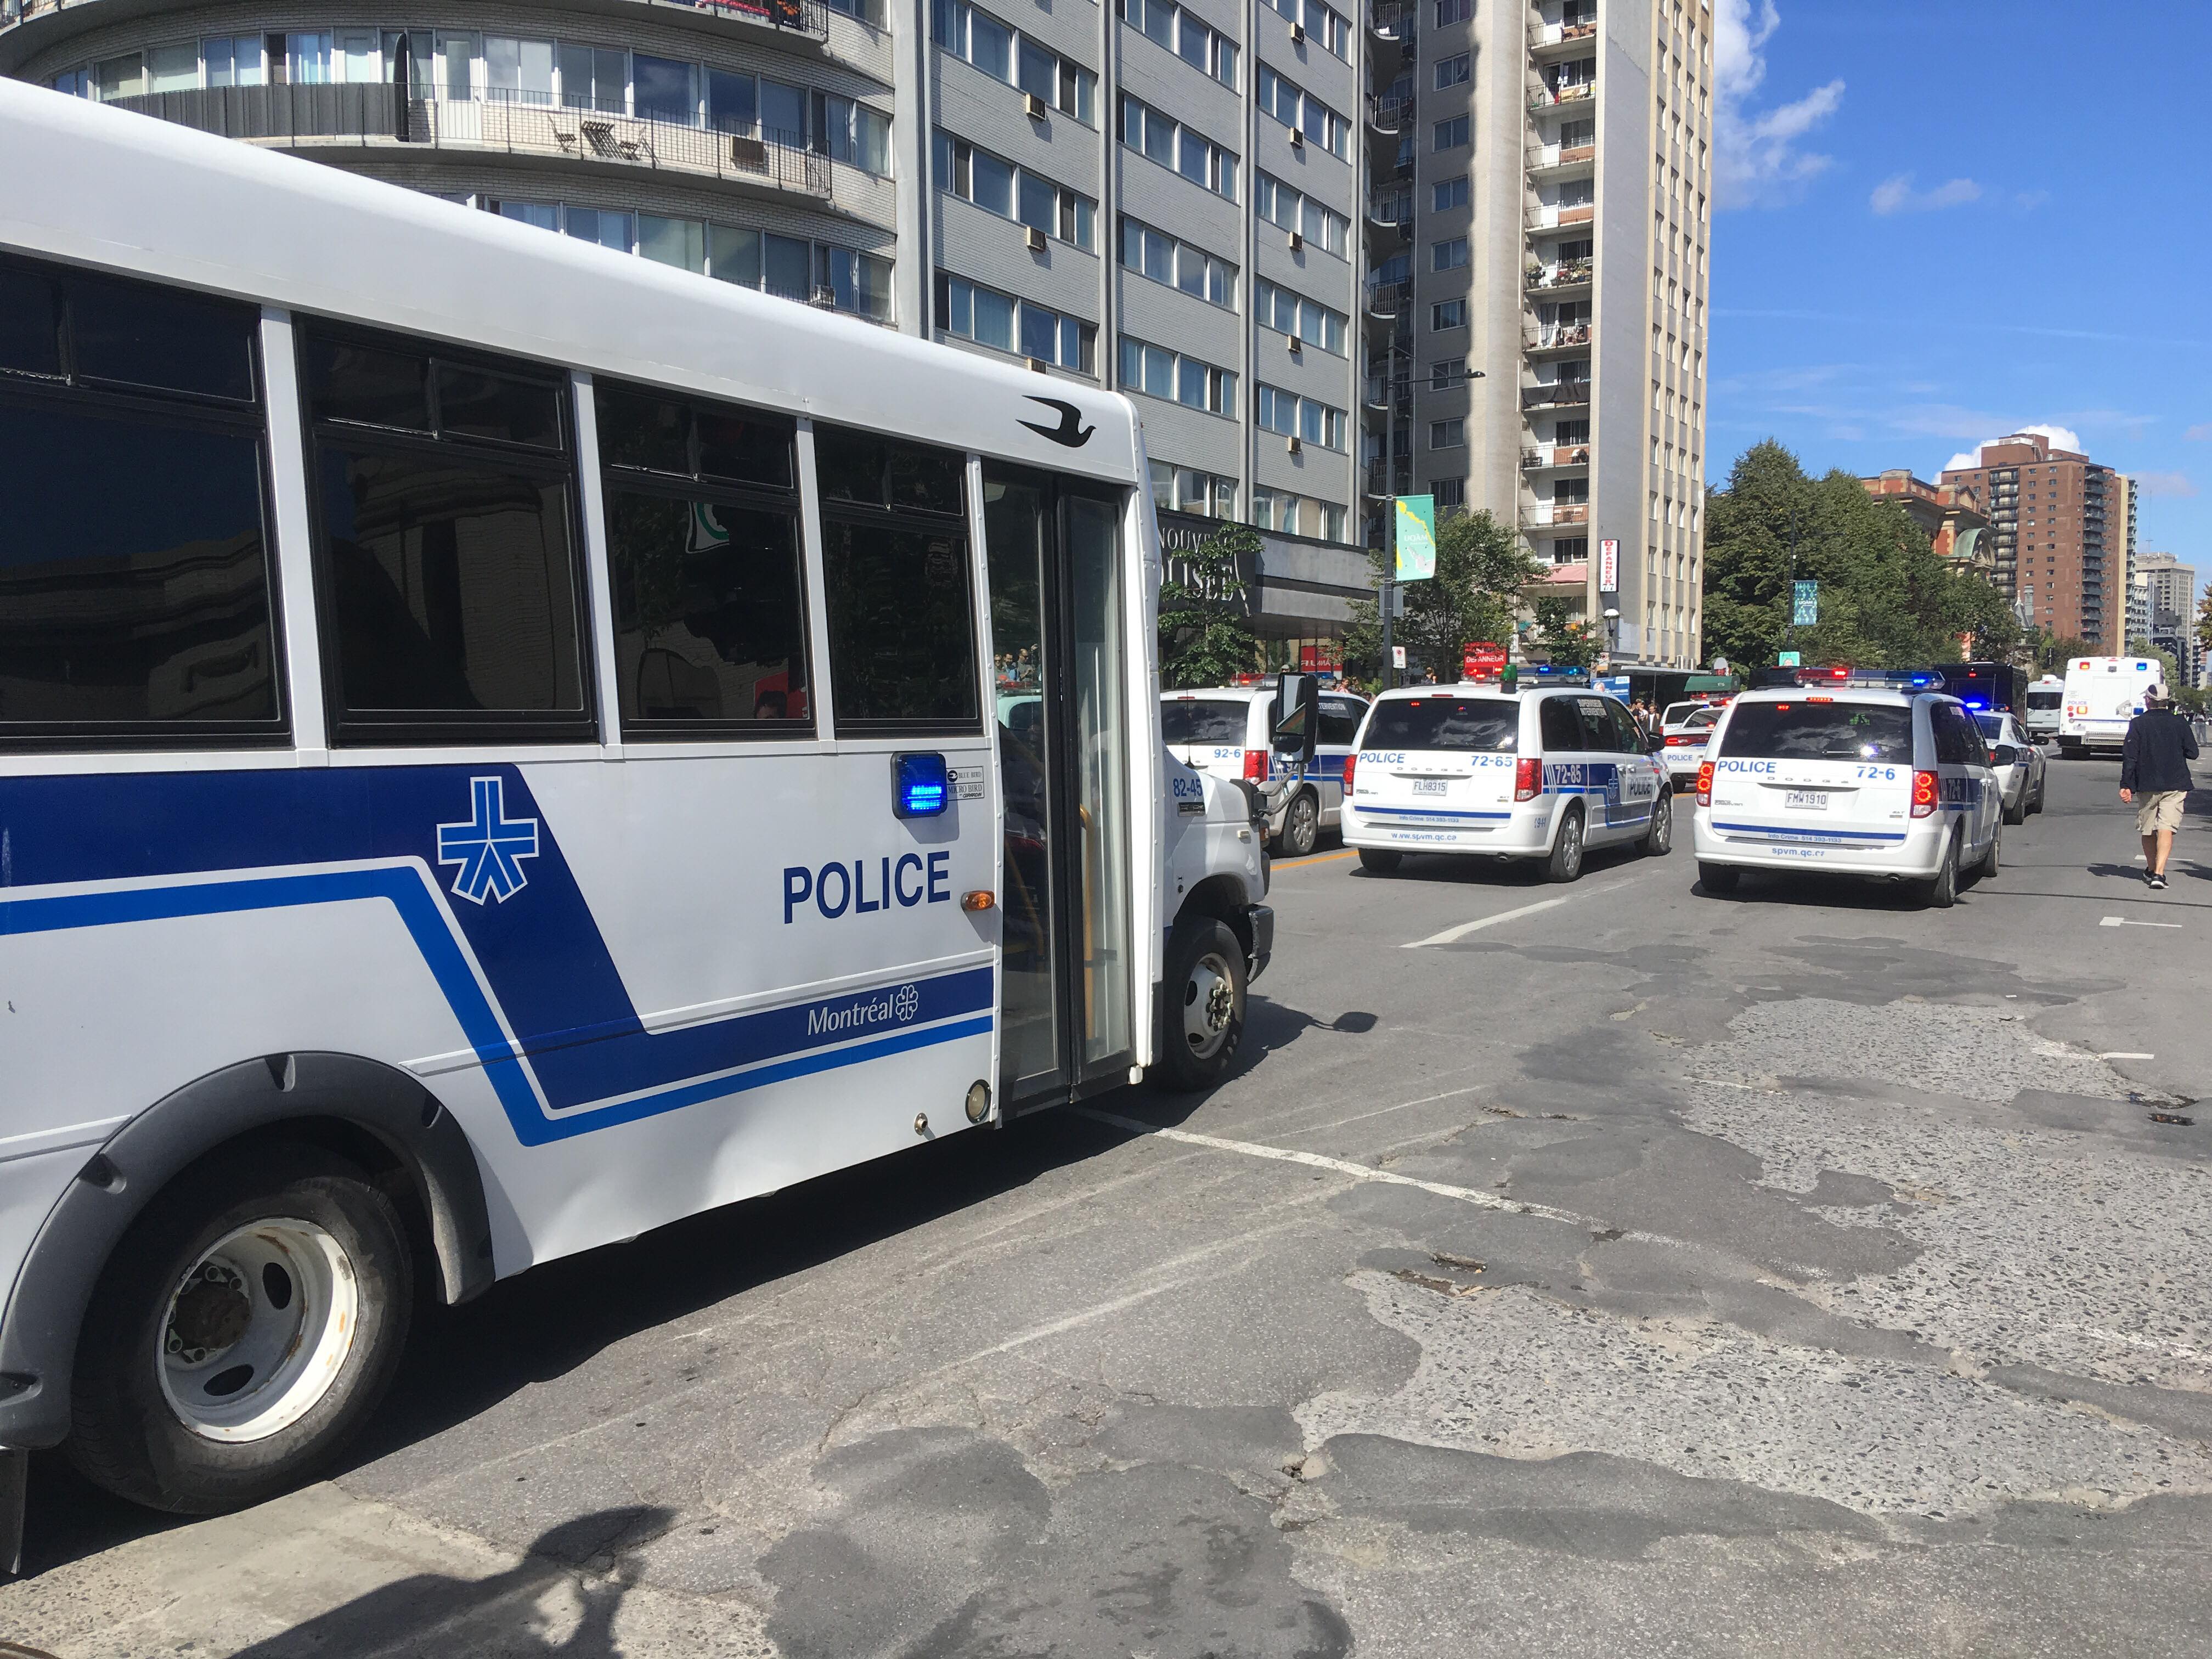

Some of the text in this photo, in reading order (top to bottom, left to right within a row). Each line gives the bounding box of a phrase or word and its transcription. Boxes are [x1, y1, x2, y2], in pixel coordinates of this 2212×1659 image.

[1214, 749, 1241, 758] 92-6
[1359, 753, 1406, 764] POLICE
[1555, 765, 1582, 785] 72-85
[1718, 760, 1895, 780] POLICE 72-6
[1173, 778, 1203, 797] 82-45
[1414, 781, 1446, 791] FLH8315
[1630, 777, 1650, 795] POLICE
[1787, 793, 1826, 804] FMW1910
[783, 850, 950, 924] POLICE
[808, 994, 894, 1036] Montréal
